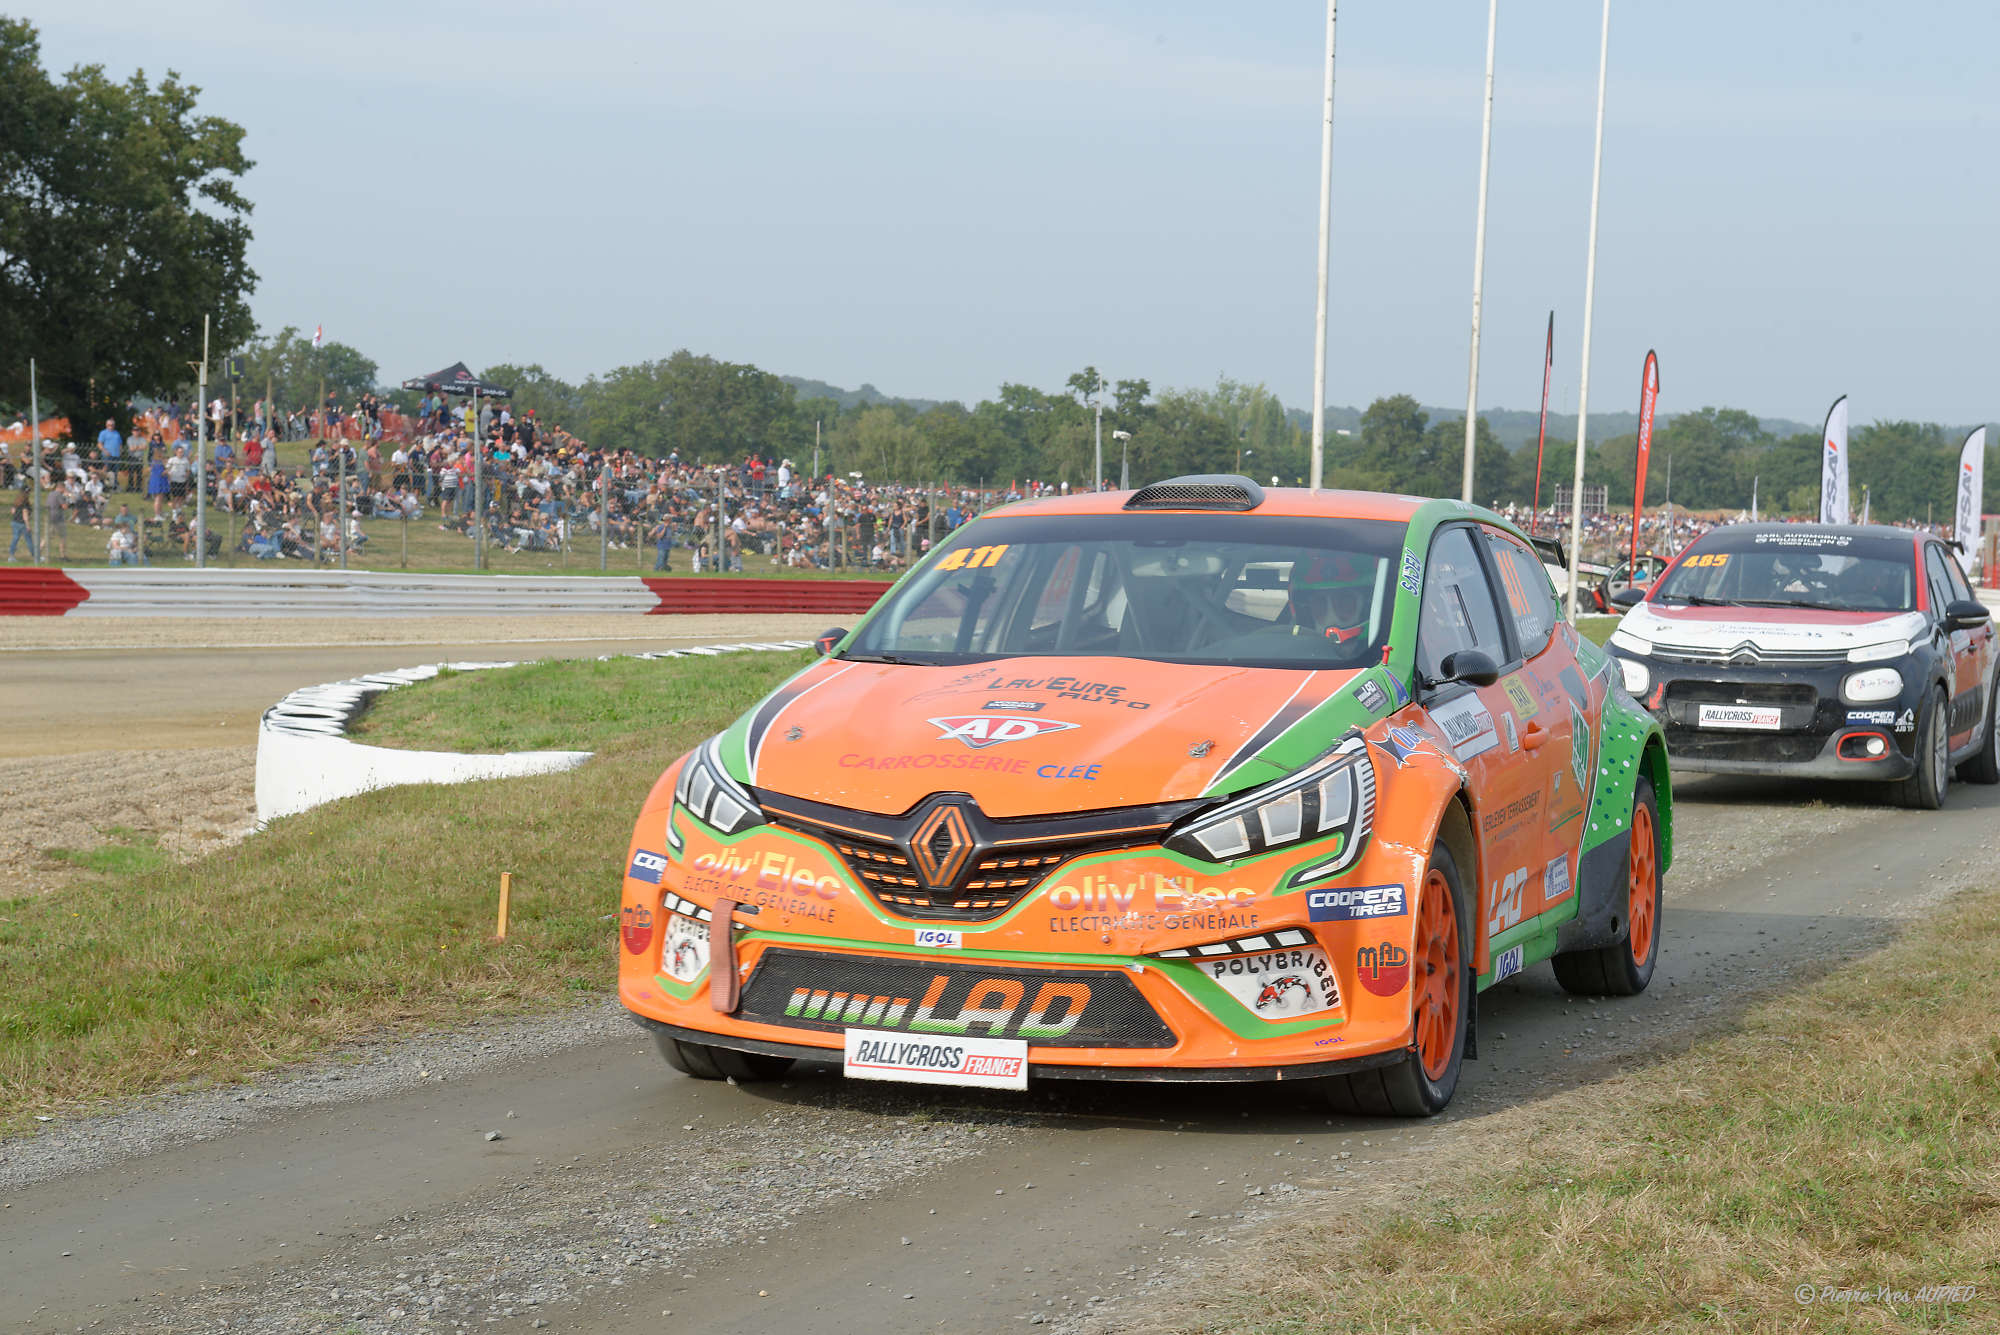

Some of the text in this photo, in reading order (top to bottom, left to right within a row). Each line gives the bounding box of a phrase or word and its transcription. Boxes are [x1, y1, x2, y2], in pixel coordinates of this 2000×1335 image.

[1825, 455, 1839, 524] FSA
[1783, 533, 1853, 541] AUTOMOBILES
[933, 544, 1010, 571] 411
[1682, 553, 1731, 569] 485
[1401, 547, 1421, 597] SADEV
[1056, 691, 1151, 710] AUTO
[1704, 709, 1753, 721] RALLYCROSS
[1846, 711, 1896, 720] COOPER
[936, 718, 1040, 741] AD
[837, 753, 1031, 775] CARROSSERIE
[693, 847, 842, 901] oliv'Elec
[1049, 873, 1258, 913] oliv'Elec
[1308, 887, 1404, 908] COOPER
[756, 891, 837, 924] GENERALE
[1349, 902, 1401, 917] TIRES
[918, 931, 954, 944] IGOL
[1357, 941, 1409, 979] MAD
[1497, 949, 1520, 982] IGOL
[1213, 951, 1341, 1007] POLYBRIBEN
[908, 975, 1092, 1039] LAD
[1314, 1036, 1345, 1047] IGOL
[855, 1039, 1020, 1077] RALLYCROSS FRANCE
